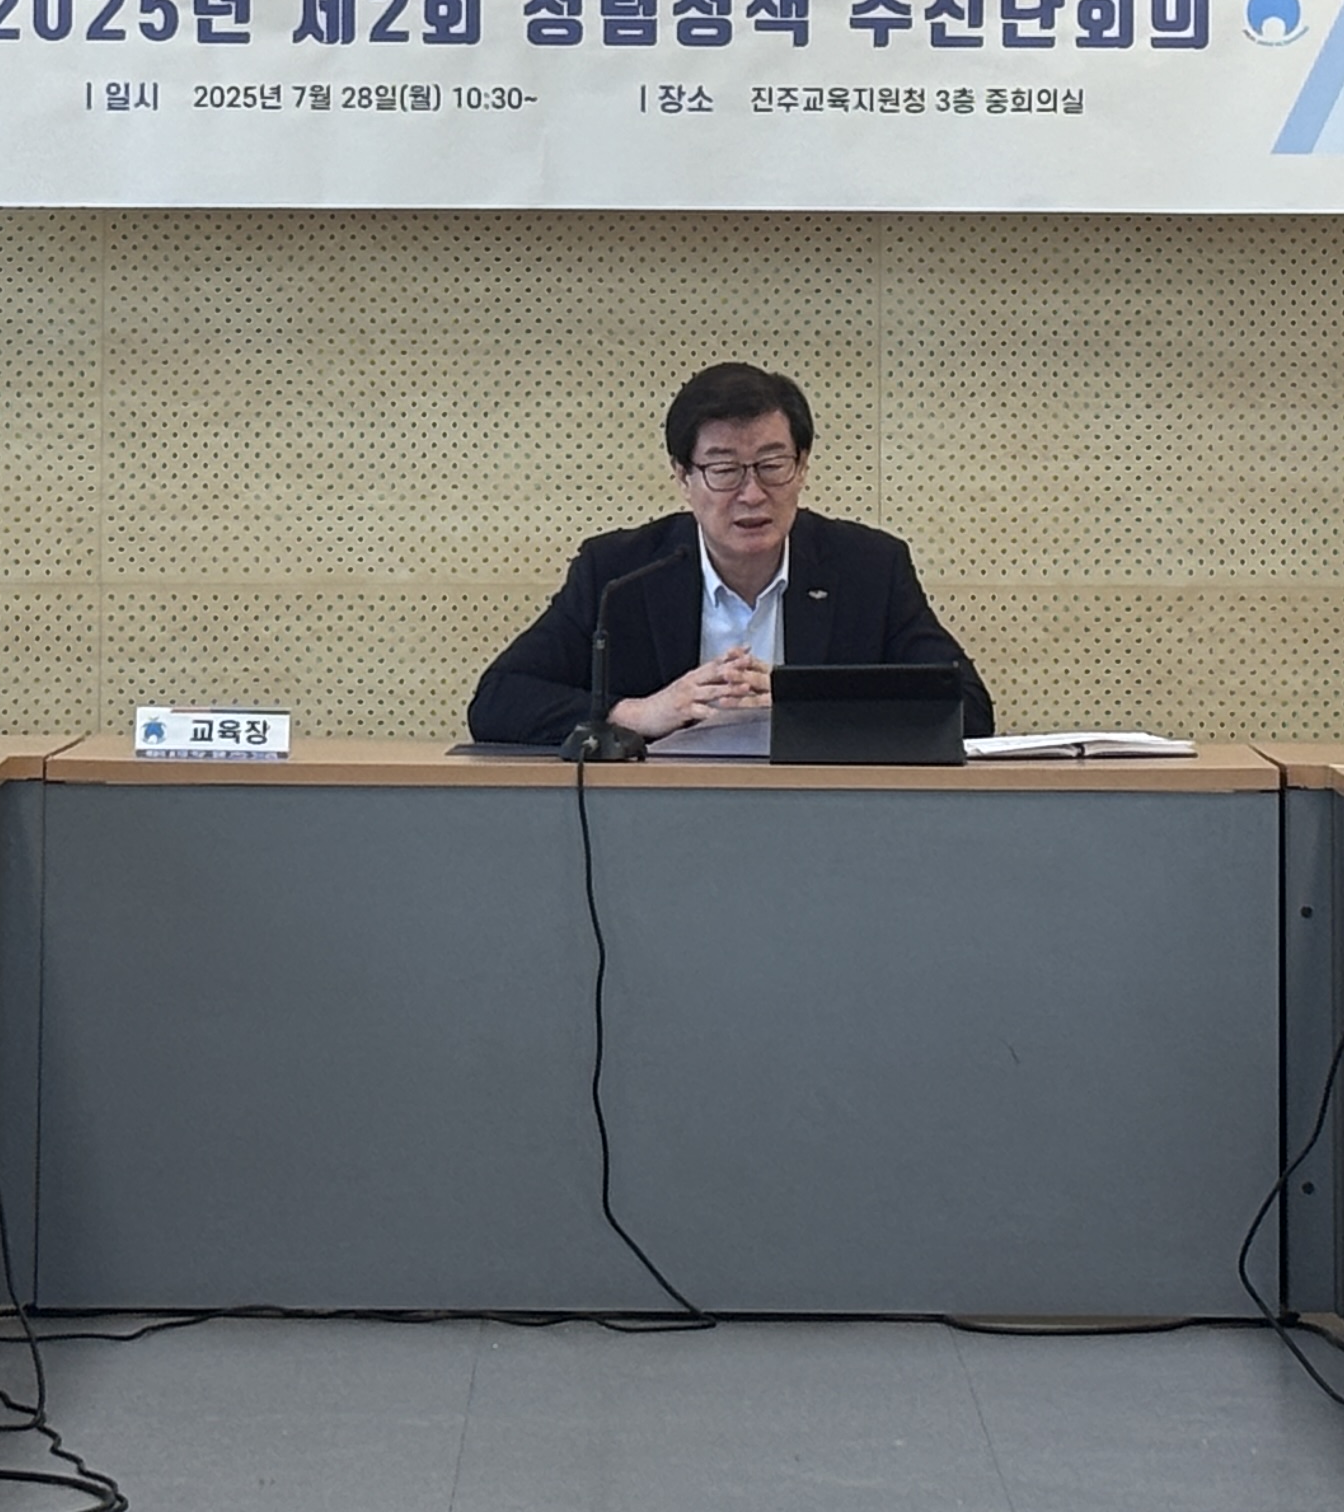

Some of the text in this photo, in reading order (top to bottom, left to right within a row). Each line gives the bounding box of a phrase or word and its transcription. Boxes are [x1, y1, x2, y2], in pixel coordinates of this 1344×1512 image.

[105, 82, 539, 113] 일시 2025년 7월 28일(월) 10:30~
[658, 84, 1084, 115] 장소 진주교육지원청 3층 중회의실
[189, 719, 271, 745] 교육장
